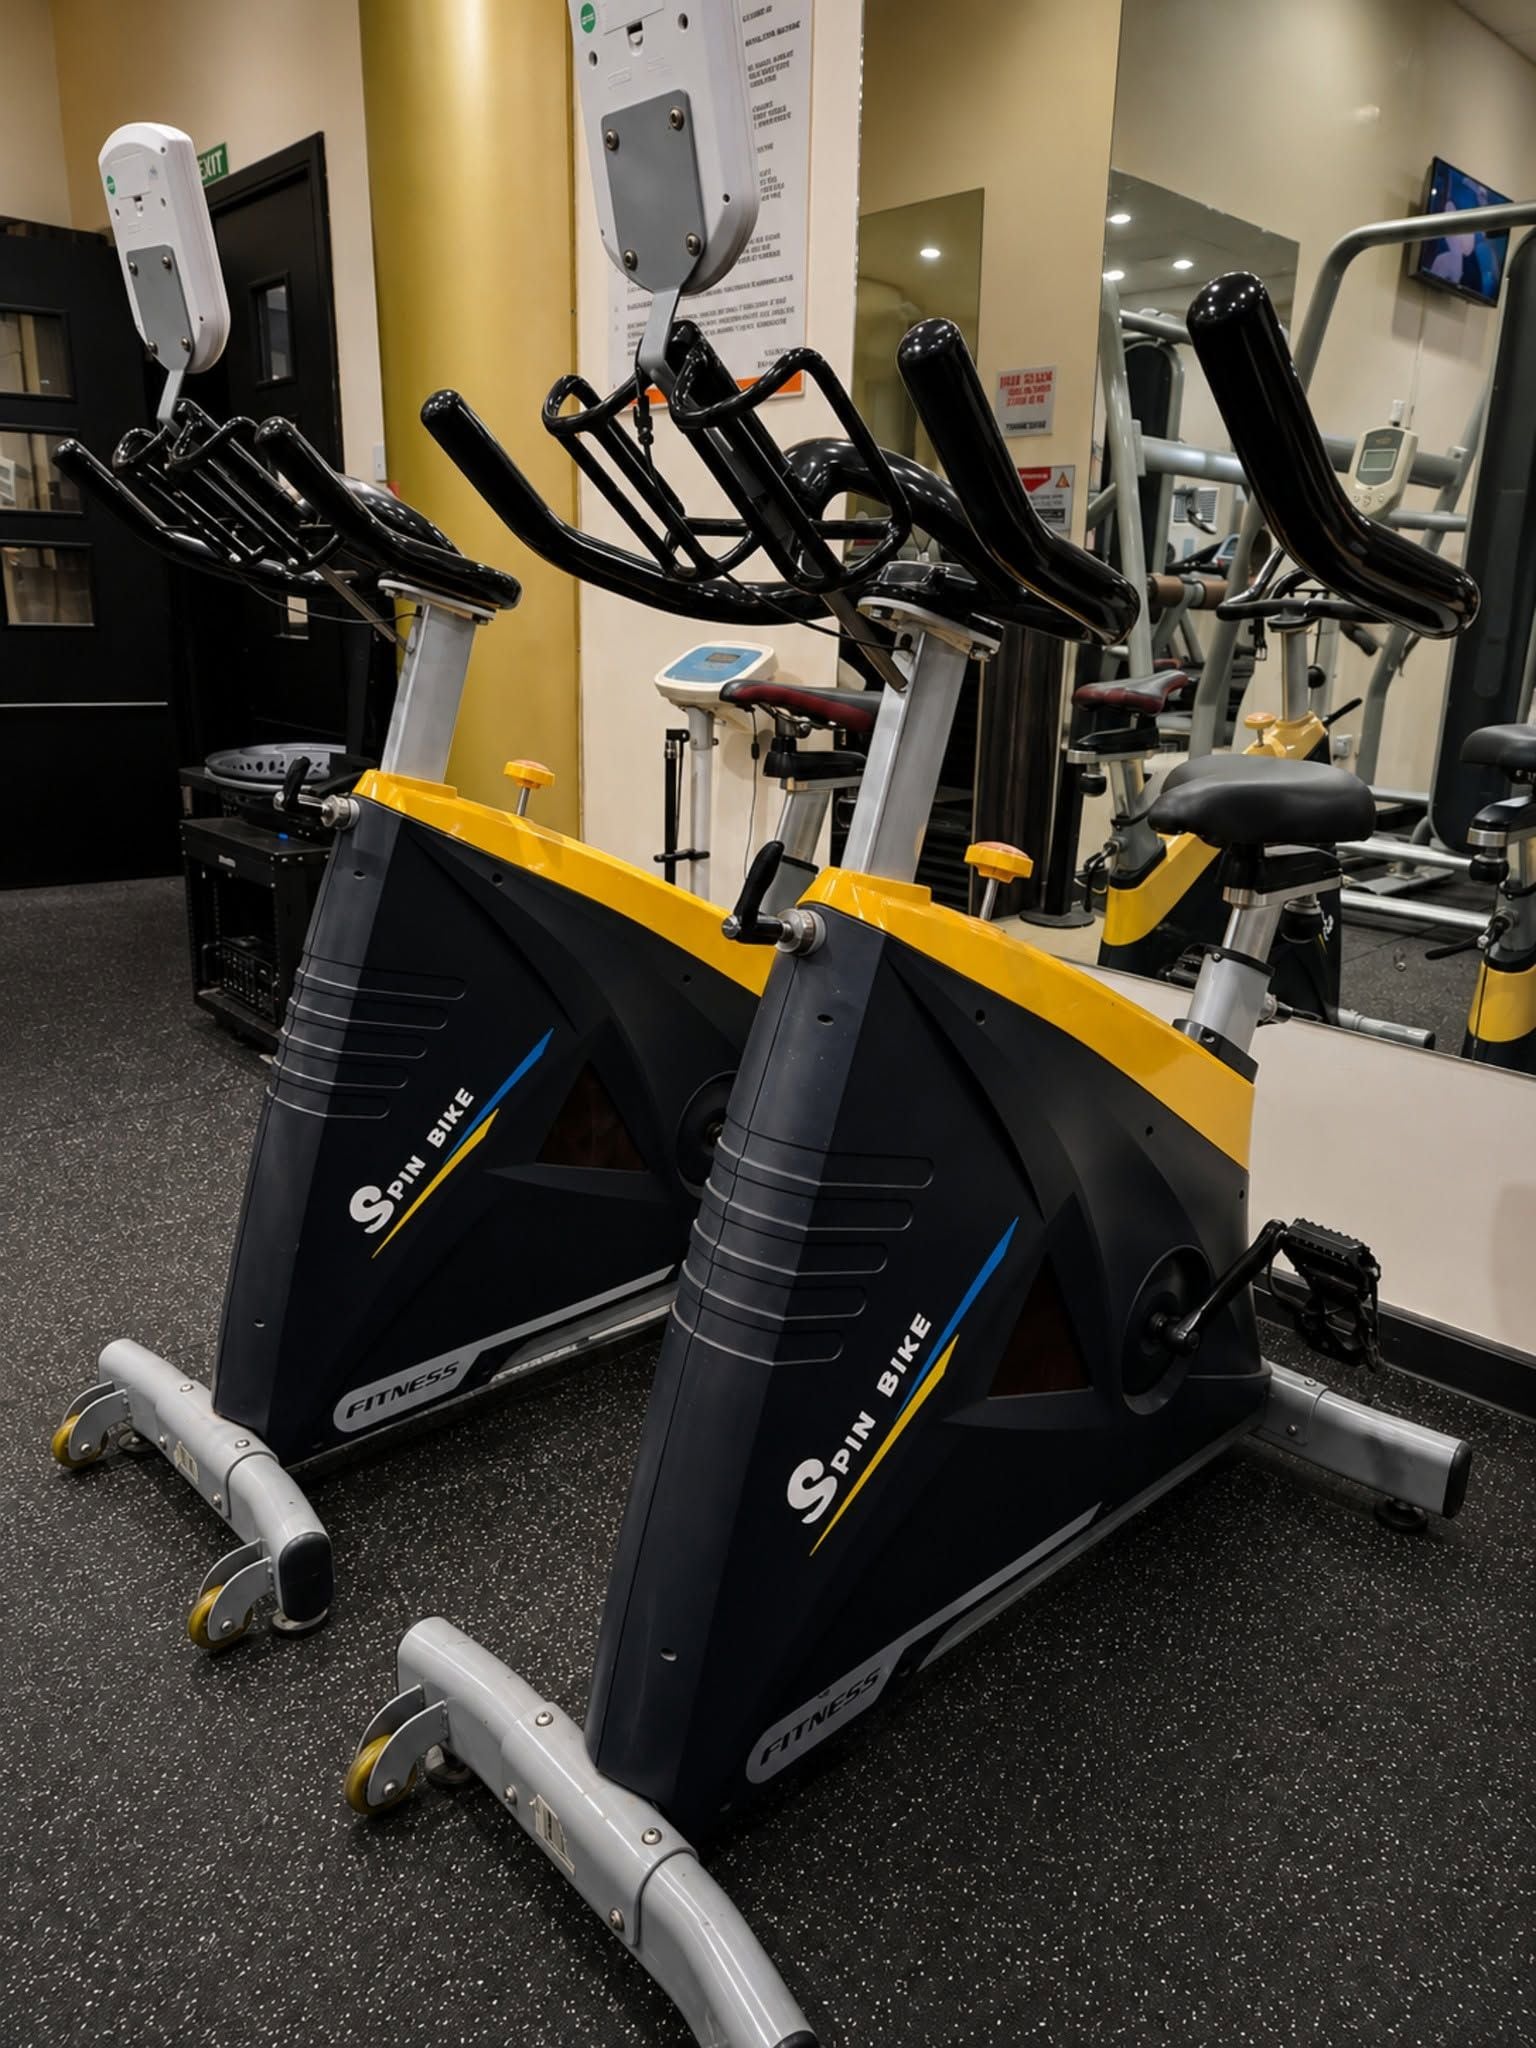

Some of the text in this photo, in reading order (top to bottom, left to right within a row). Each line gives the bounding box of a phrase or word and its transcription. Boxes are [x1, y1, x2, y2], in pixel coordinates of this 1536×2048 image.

[198, 150, 223, 180] EXIT
[349, 1087, 475, 1234] SPIN BIKE
[346, 1361, 460, 1419] FITNESS
[787, 1312, 932, 1524] SPIN BIKE
[760, 1667, 881, 1766] FITNESS
